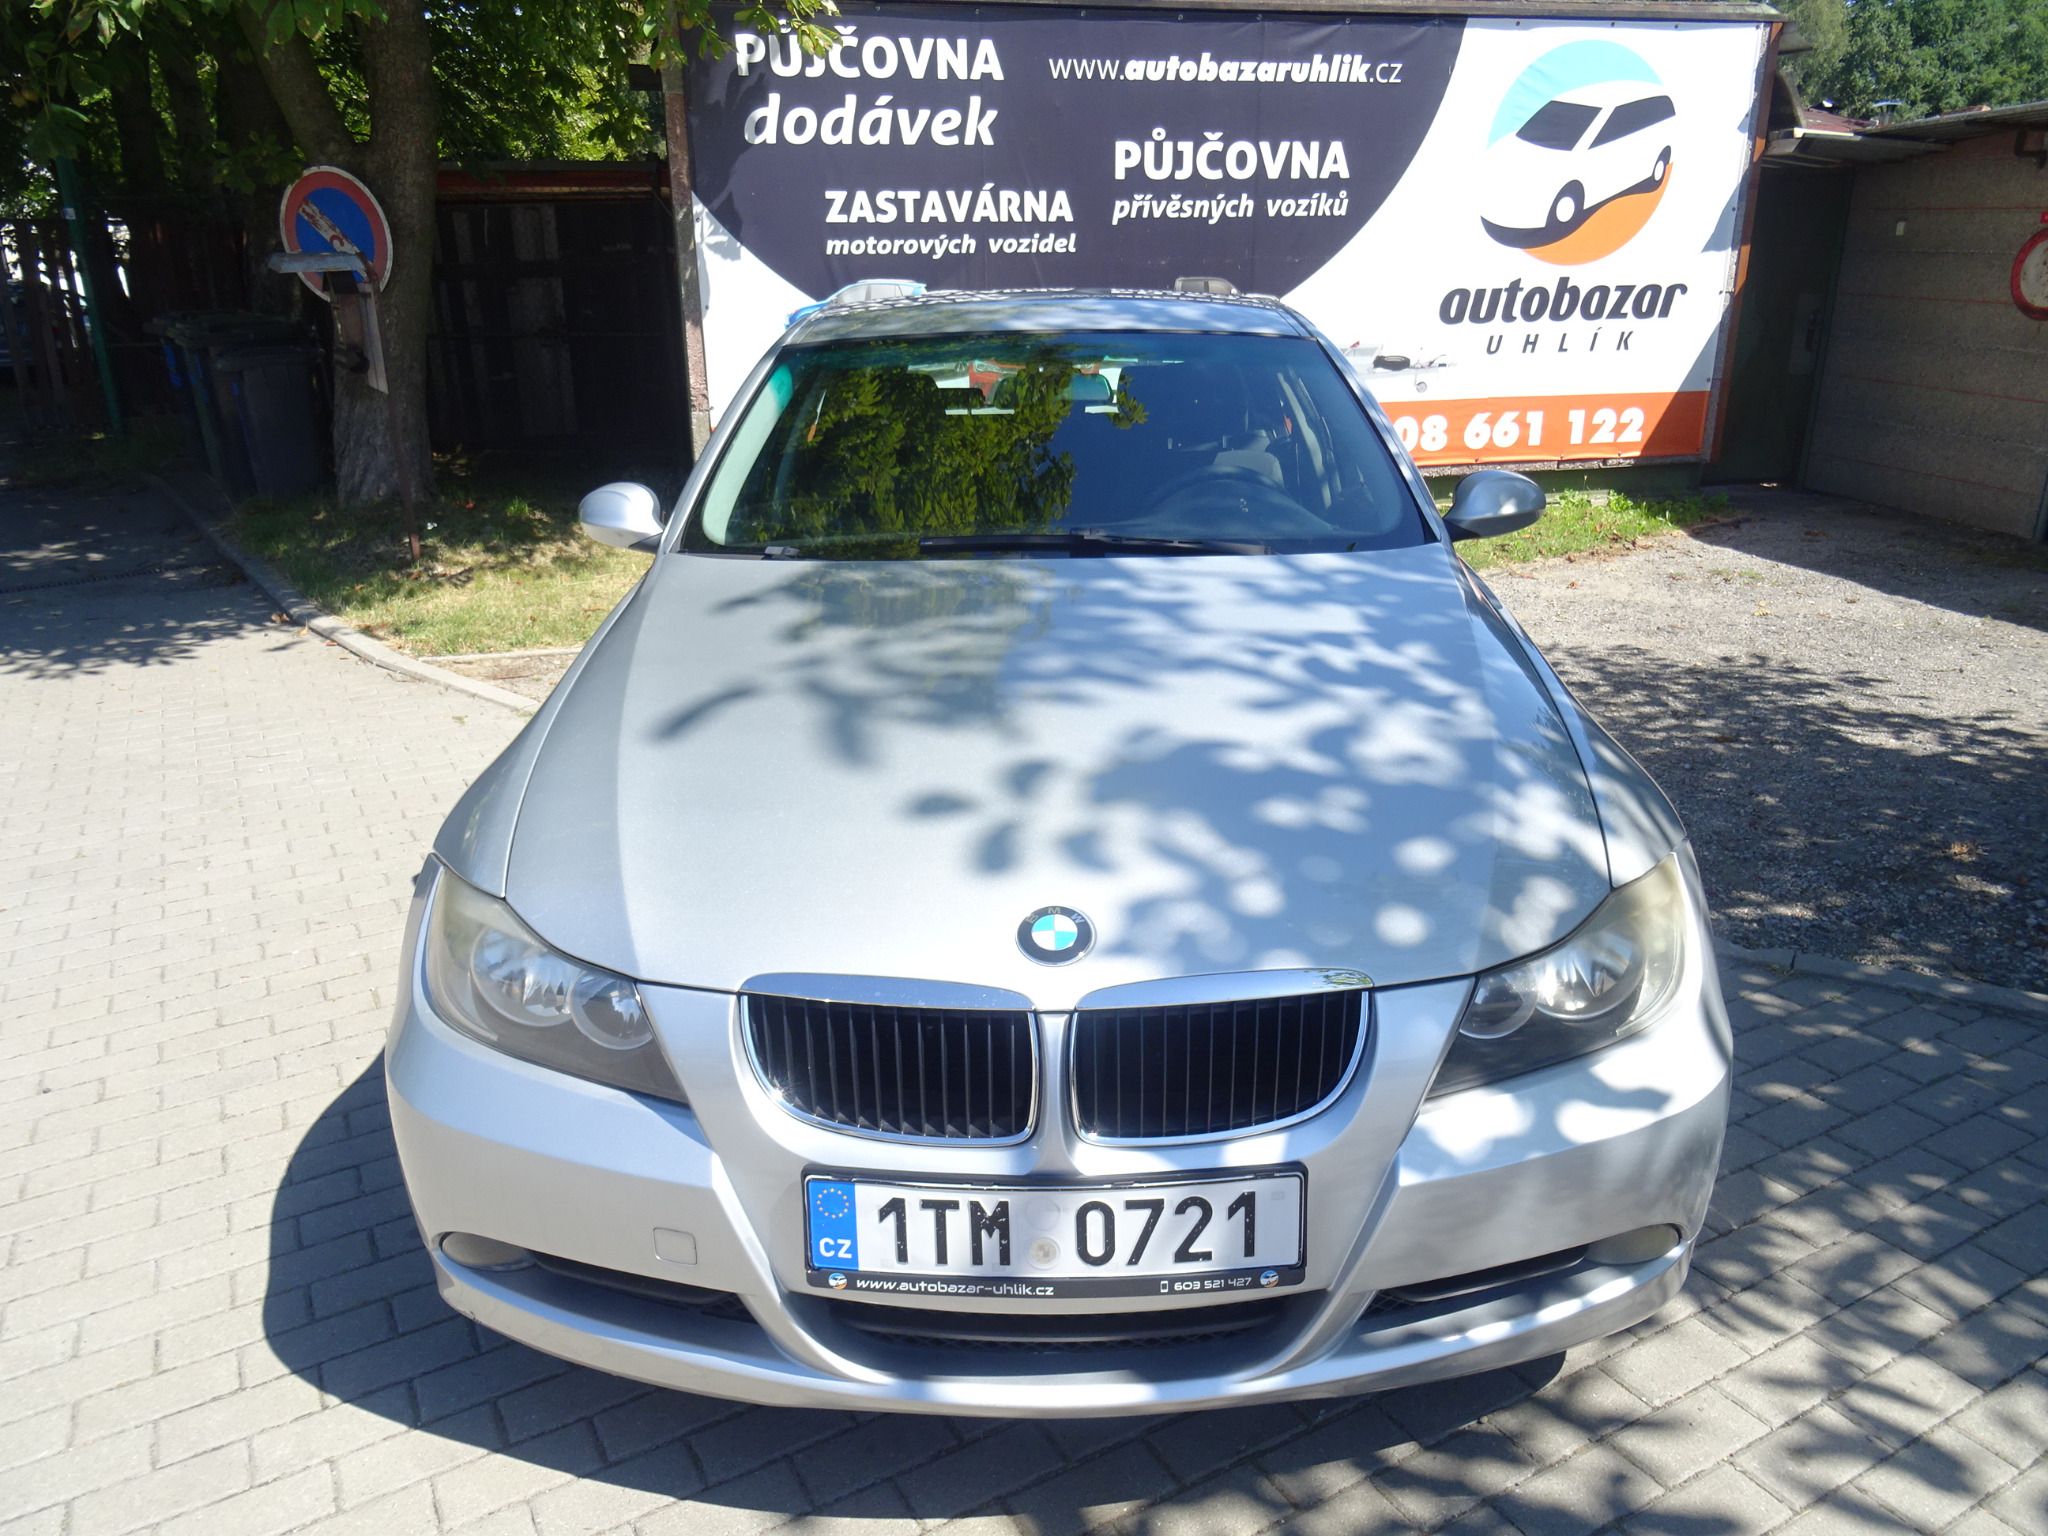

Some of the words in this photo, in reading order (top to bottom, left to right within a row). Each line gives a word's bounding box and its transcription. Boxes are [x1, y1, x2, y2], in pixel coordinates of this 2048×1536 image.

[1048, 53, 1404, 84] www.autobazaruhlik.cz
[744, 93, 999, 146] dodávek
[1114, 127, 1350, 181] PŮJČOVNA
[824, 183, 1074, 224] ZASTAVÁRNA
[1112, 193, 1254, 226] přívěsných
[1266, 190, 1350, 218] vozíků
[826, 234, 976, 260] motorových
[988, 233, 1077, 254] vozidel
[1438, 276, 1688, 325] autobazar
[1486, 326, 1634, 355] UHLÍK
[1463, 410, 1544, 450] 661
[1568, 407, 1645, 445] 122
[1025, 906, 1086, 925] BMW
[877, 1196, 1012, 1267] 1TM
[1074, 1190, 1256, 1267] 0721
[818, 1237, 853, 1259] CZ
[856, 1278, 1055, 1297] www.autobazar-uhlik.cz
[1173, 1281, 1201, 1291] 603
[1204, 1279, 1225, 1289] 521
[1228, 1277, 1252, 1287] 427
